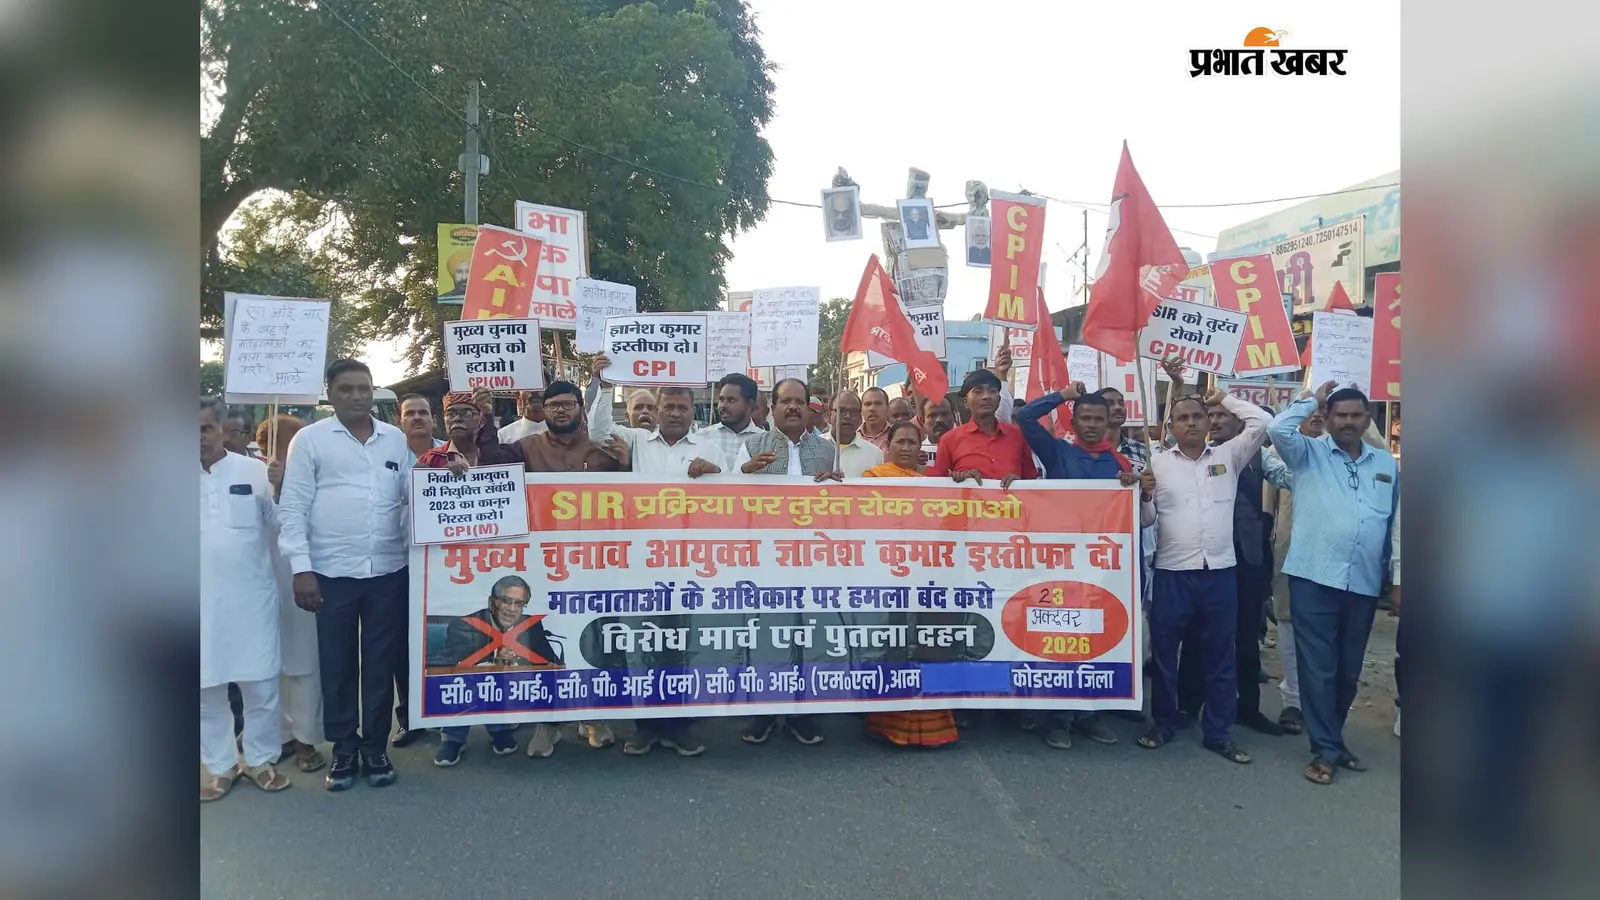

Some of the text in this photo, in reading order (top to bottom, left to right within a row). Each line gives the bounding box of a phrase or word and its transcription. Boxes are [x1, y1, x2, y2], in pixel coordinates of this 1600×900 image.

[1152, 304, 1239, 334] SIR को तुरंत
[452, 323, 527, 341] मुख्य चुनाव
[610, 320, 702, 338] ज्ञानेश कुमार
[1170, 325, 1212, 346] रोको।
[456, 338, 526, 358] आयुक्त को
[611, 337, 698, 354] इस्तीफा दो।
[1149, 339, 1222, 371] CPI(M)
[466, 357, 515, 373] हटाओ।
[633, 360, 676, 377] CPI
[468, 376, 515, 389] CPI(M)
[470, 470, 509, 482] आयुक्त
[422, 481, 516, 499] की नियुक्ति संबंधी
[429, 497, 510, 511] 2023 का कानून
[551, 487, 1022, 526] SIR प्रक्रिया पर तुरंत रोक लगाओ
[438, 513, 472, 525] निरस्त
[444, 523, 499, 538] CPI(M)
[440, 531, 1124, 584] मुख्य चुनाव आयुक्त ज्ञानेश कुमार इस्तीफा दो
[548, 580, 995, 615] मतदाताओं के अधिकार पर हमला बंद करो
[601, 617, 976, 657] विरोध मार्च एवं पुतला दहन
[1042, 636, 1091, 655] 2026
[622, 668, 654, 699] आई
[658, 668, 701, 700] (एम)
[1011, 663, 1074, 689] कोडरमा
[1076, 663, 1115, 690] जिला
